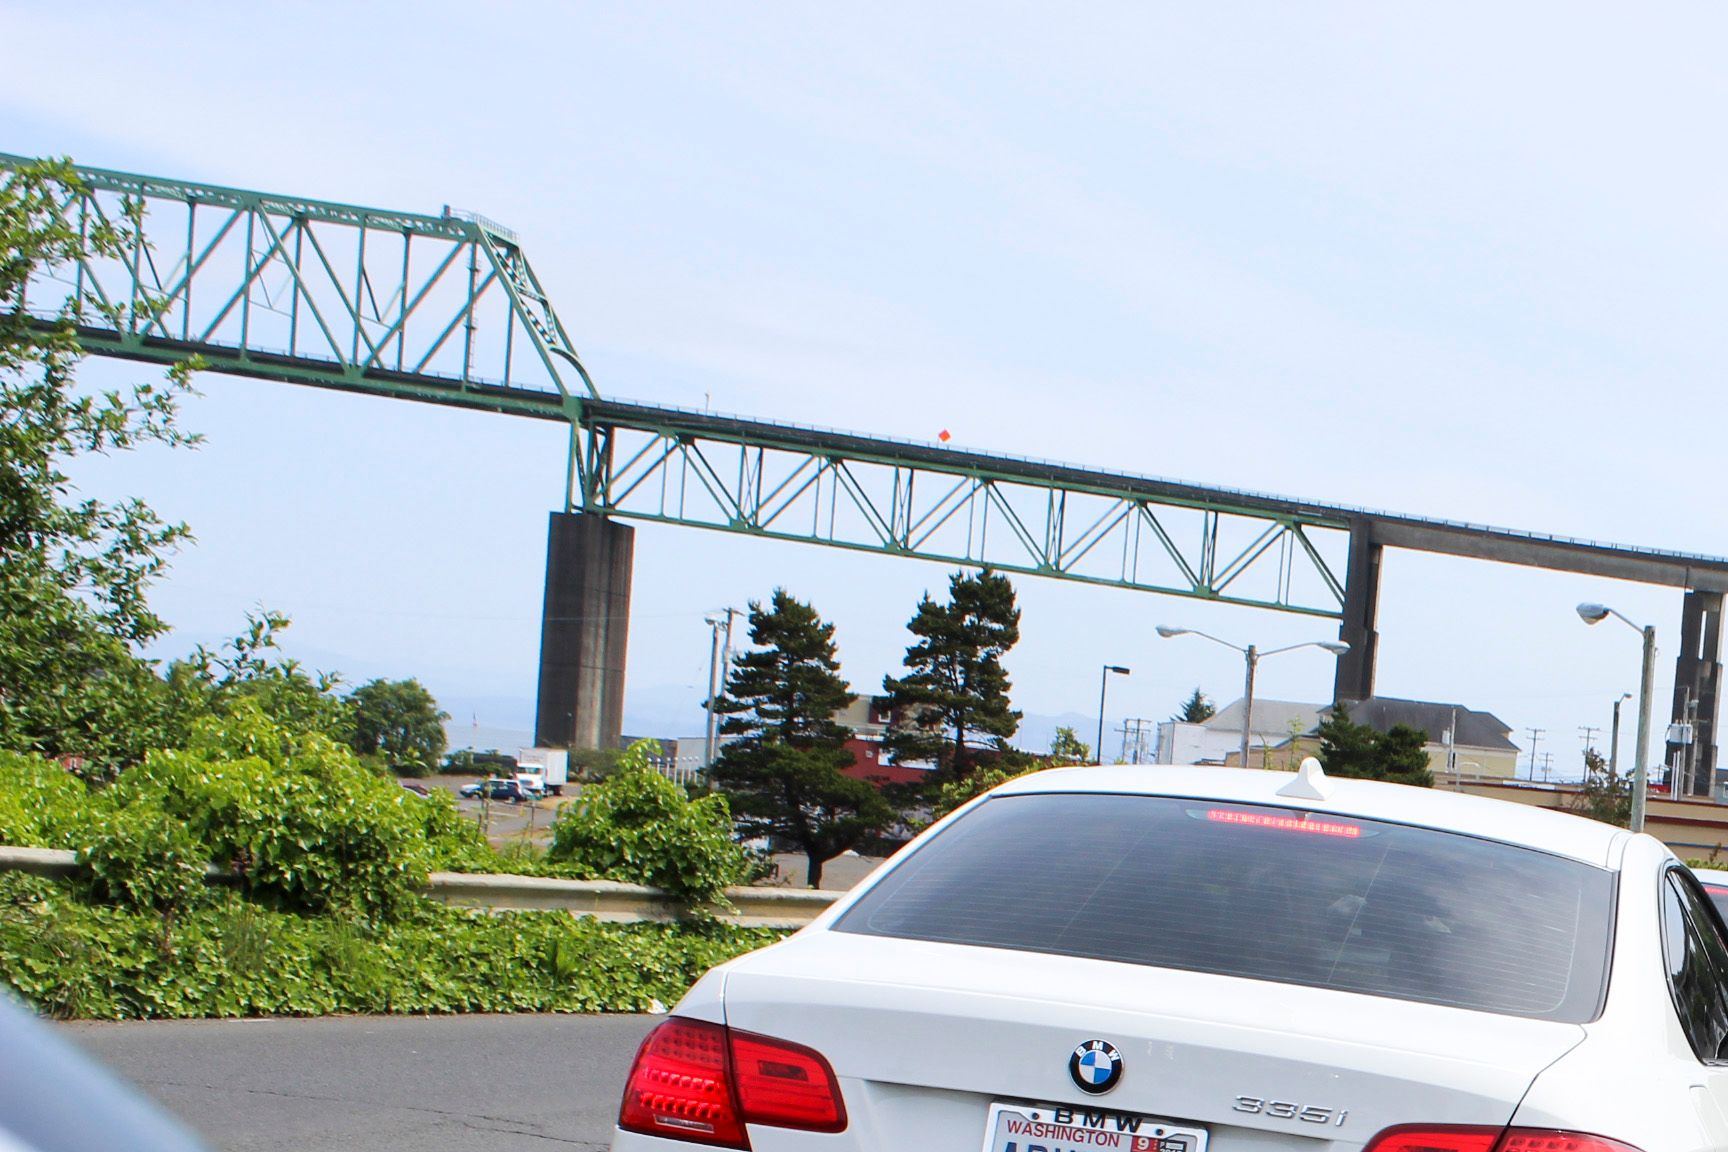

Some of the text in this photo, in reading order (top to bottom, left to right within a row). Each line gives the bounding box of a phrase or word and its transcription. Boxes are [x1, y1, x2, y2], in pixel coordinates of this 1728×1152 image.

[1075, 1040, 1120, 1061] BMW
[1053, 1107, 1143, 1133] BMW
[1232, 1095, 1349, 1126] 335i
[1006, 1120, 1120, 1148] WASHINGTON
[1137, 1137, 1149, 1150] 9
